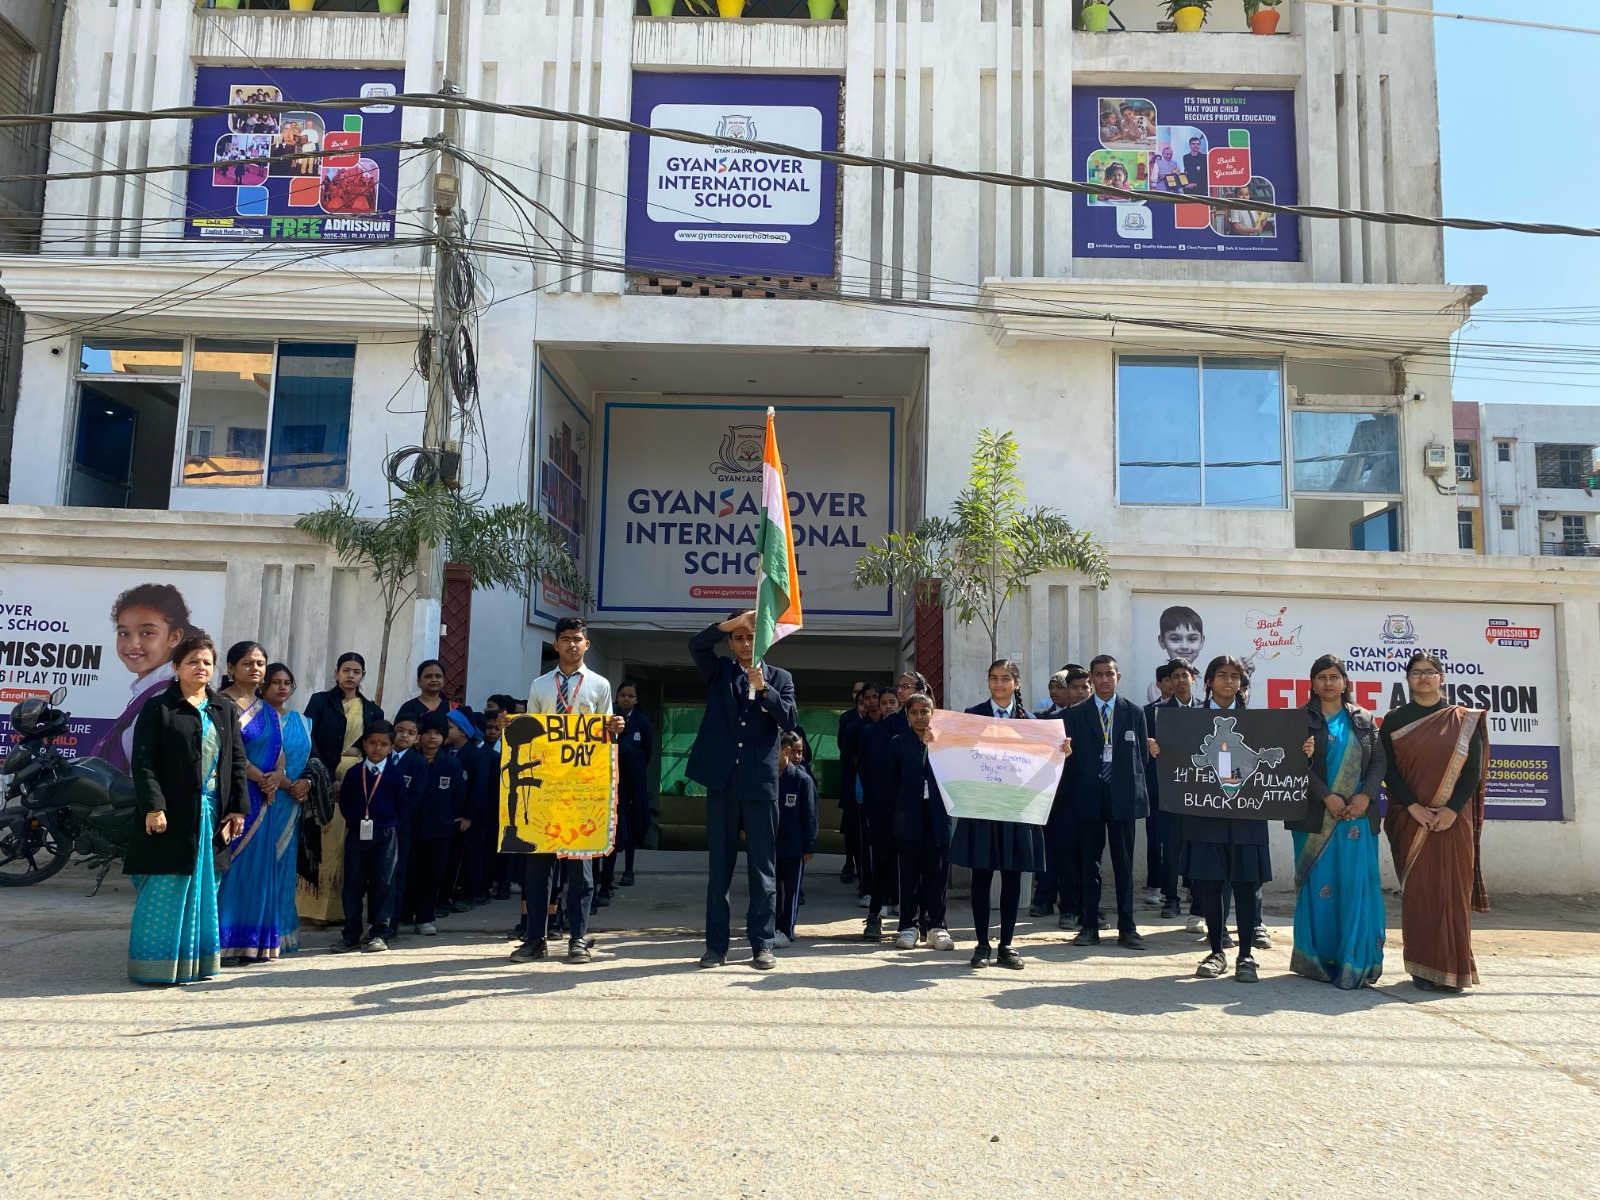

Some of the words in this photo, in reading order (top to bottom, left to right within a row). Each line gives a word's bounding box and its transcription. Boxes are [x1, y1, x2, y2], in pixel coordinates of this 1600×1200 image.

[666, 156, 803, 174] GYANSAROVER
[1217, 156, 1236, 164] Back
[658, 176, 810, 192] INTERNATIONAL
[694, 192, 772, 209] SCHOOL
[270, 218, 322, 239] FREE
[324, 218, 391, 232] ADMISSION
[678, 230, 788, 241] www.gyansaroverschool.com
[718, 474, 763, 482] GYANSARO
[628, 488, 868, 518] GYANSAOVER
[626, 522, 866, 548] INTERNAONAL
[684, 551, 807, 576] SCHOL
[703, 589, 757, 598] www.gyansarov
[8, 618, 70, 632] SCHOOL
[1256, 617, 1284, 630] Back
[1270, 628, 1280, 637] to
[1486, 628, 1528, 638] ADMISSION
[1530, 630, 1538, 638] IS
[1253, 636, 1295, 650] Gurukul
[1342, 660, 1408, 672] RNATION
[16, 670, 48, 684] PLAY
[52, 672, 67, 685] TO
[72, 673, 98, 686] VIIIth
[1, 691, 26, 700] Enroll
[1390, 682, 1538, 714] AISSION
[1490, 718, 1506, 732] TO
[52, 736, 78, 746] HILD
[560, 743, 596, 768] DAY
[1254, 772, 1309, 788] PULWAMA
[1184, 792, 1232, 810] BLACK
[1238, 797, 1264, 810] DAY
[1263, 789, 1308, 801] ATTACK
